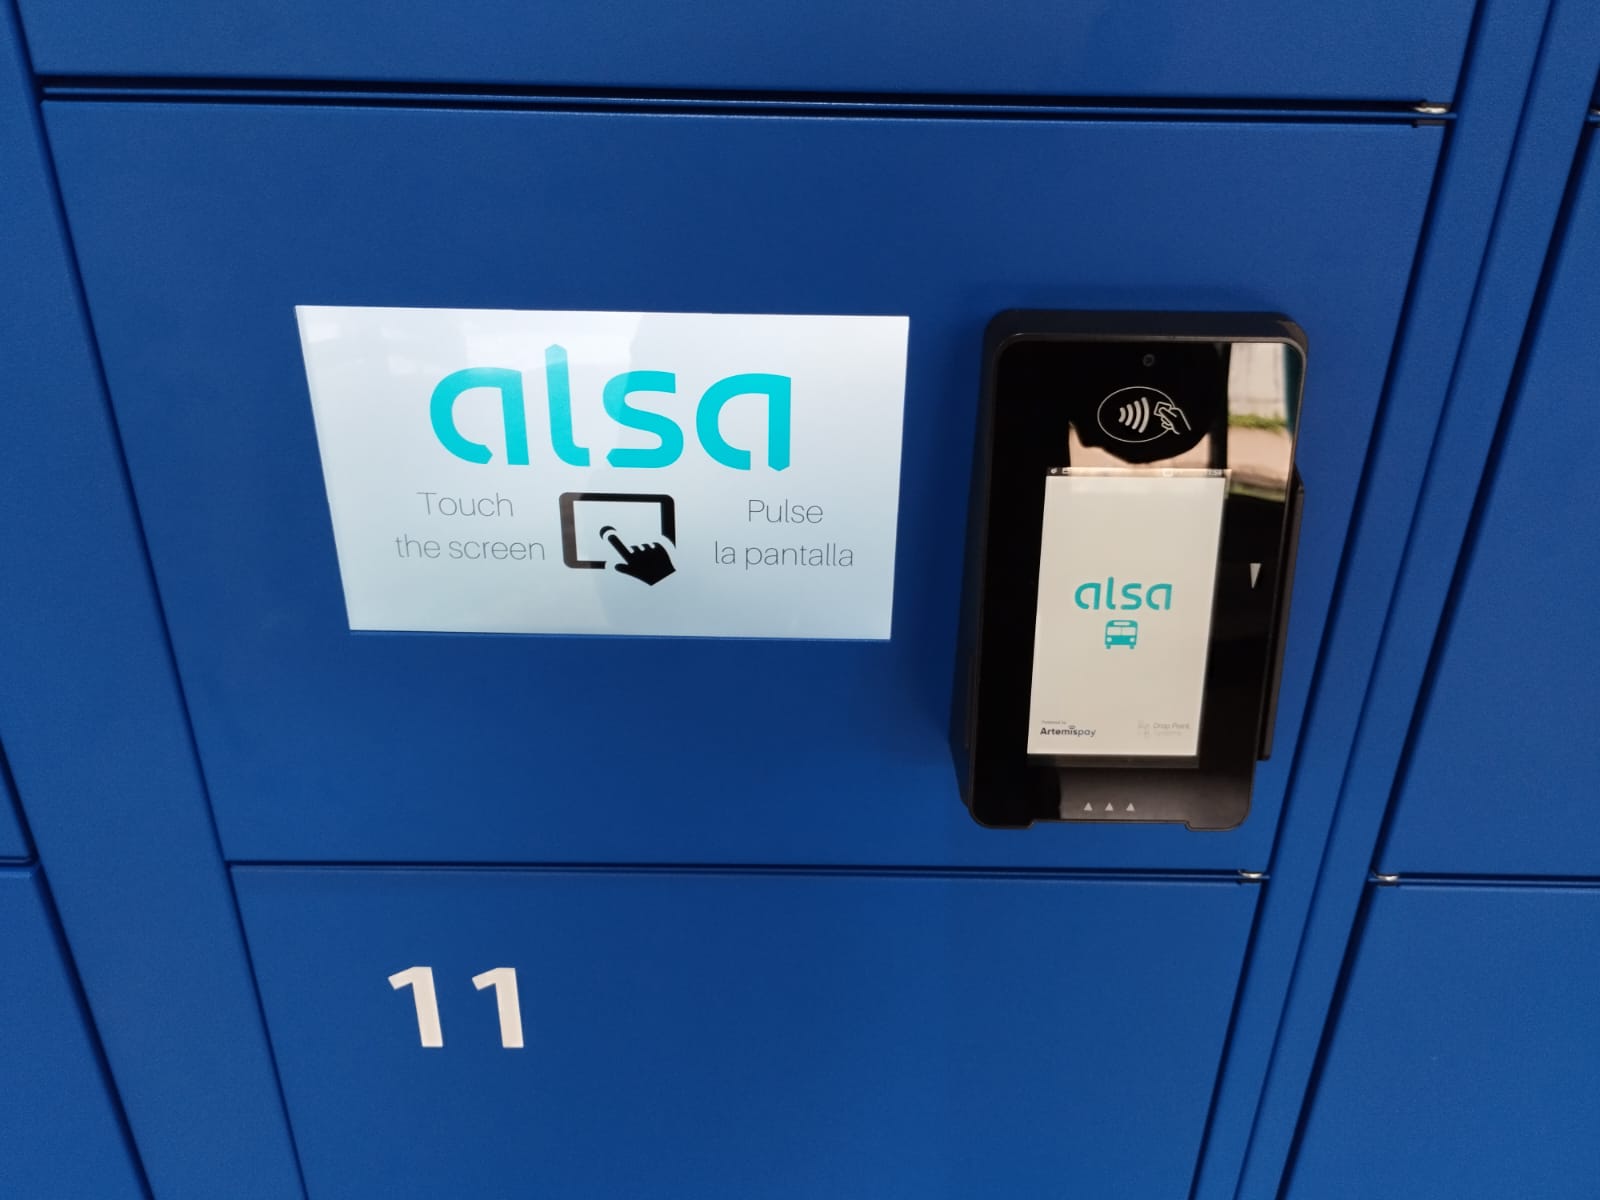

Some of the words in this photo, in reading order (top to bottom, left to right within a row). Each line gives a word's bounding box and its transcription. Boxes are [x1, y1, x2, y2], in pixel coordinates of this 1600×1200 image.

[430, 344, 791, 471] alsa
[416, 491, 515, 517] Touch
[748, 498, 824, 524] Pulse
[395, 533, 443, 560] the
[448, 536, 546, 561] screen
[714, 540, 736, 566] la
[744, 542, 854, 571] pantalla
[1074, 576, 1172, 610] alsa
[1040, 725, 1096, 738] Artemispay
[388, 966, 524, 1048] 11
